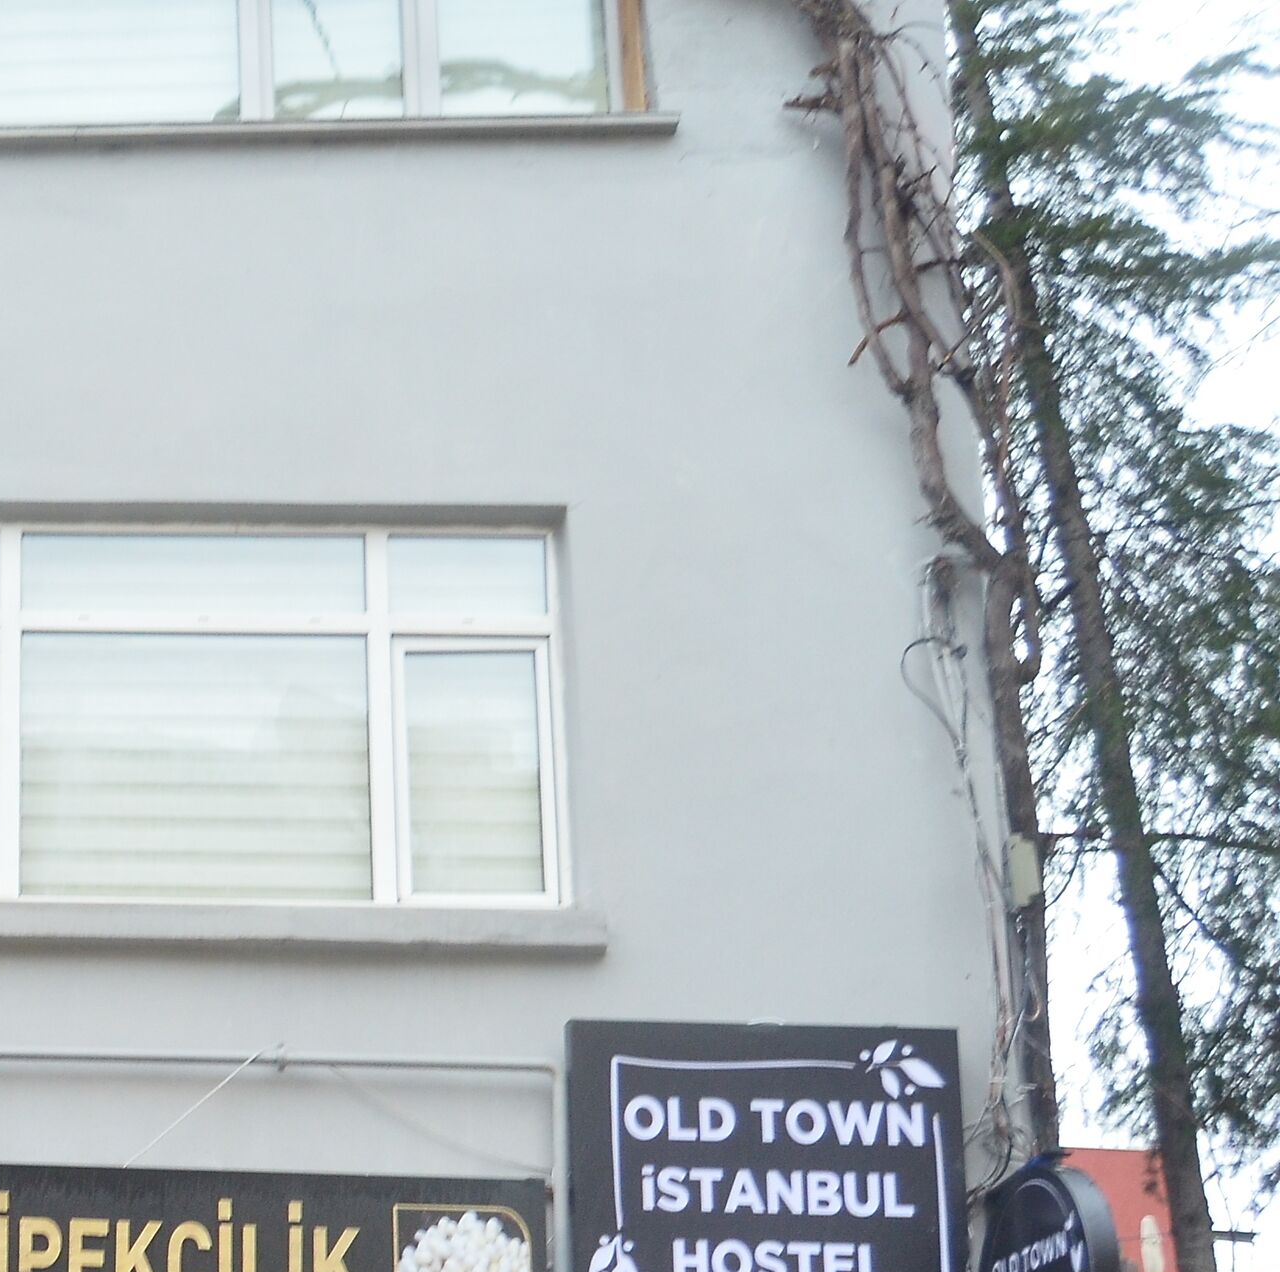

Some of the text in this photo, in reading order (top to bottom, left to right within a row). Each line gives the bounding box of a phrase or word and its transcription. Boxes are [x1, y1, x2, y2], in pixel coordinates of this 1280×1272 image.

[623, 1094, 926, 1148] OLD TOWN
[1022, 1231, 1068, 1272] TOWN
